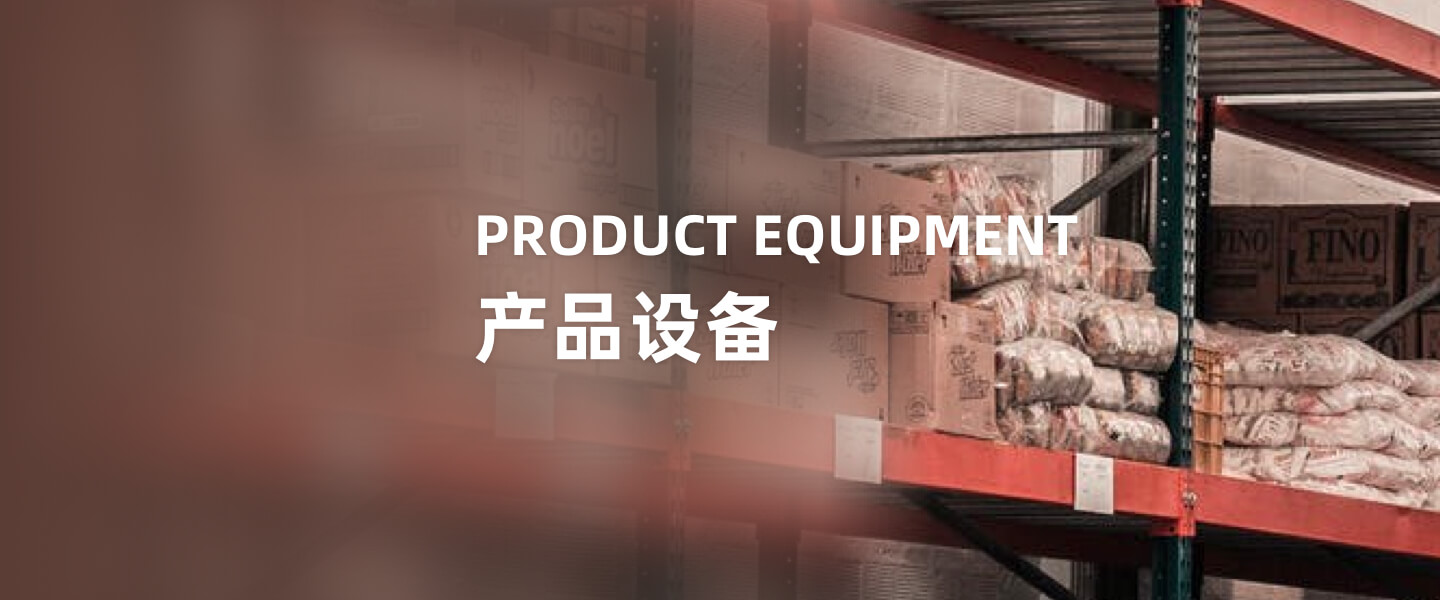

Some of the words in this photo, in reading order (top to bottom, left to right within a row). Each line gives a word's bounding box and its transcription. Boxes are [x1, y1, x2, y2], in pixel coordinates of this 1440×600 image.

[550, 114, 616, 166] noel
[1217, 228, 1268, 253] FINO
[1306, 228, 1381, 263] FINO
